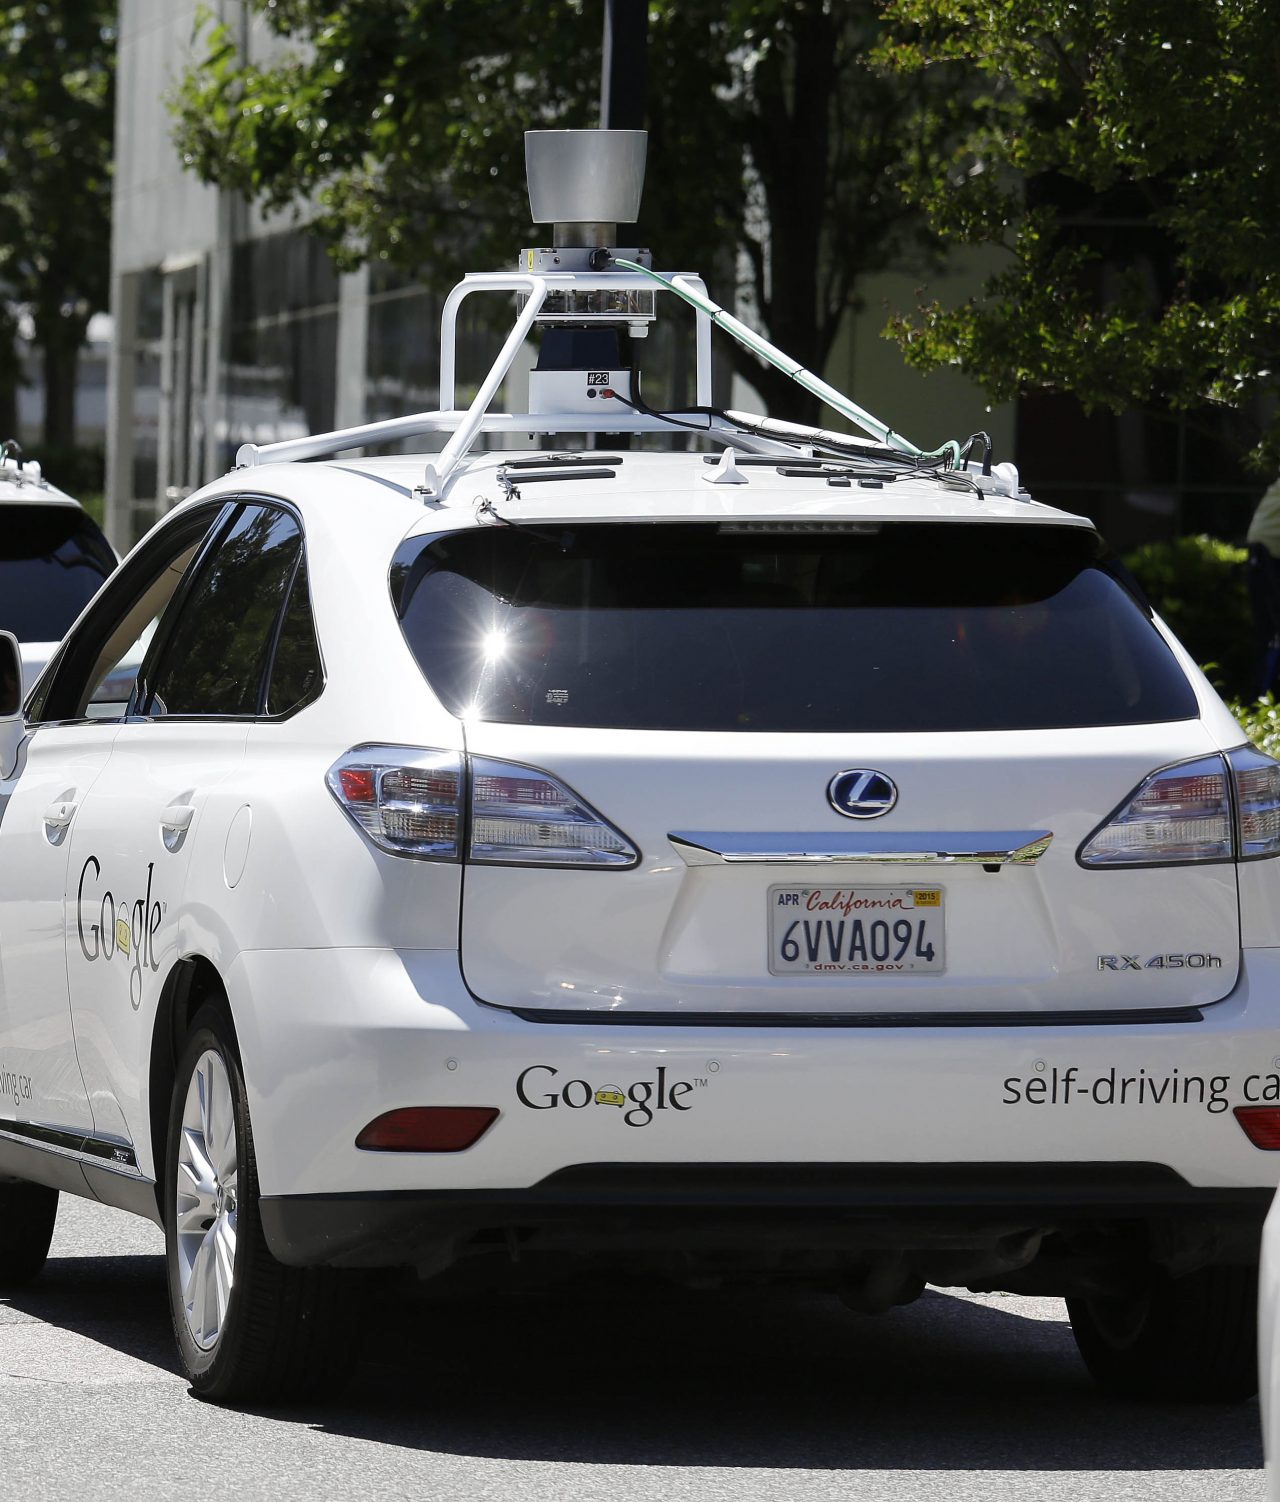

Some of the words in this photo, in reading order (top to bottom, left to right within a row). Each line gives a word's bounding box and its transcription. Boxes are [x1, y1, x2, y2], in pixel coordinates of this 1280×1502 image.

[588, 373, 609, 384] #23
[777, 893, 799, 906] APR
[806, 890, 914, 917] California
[780, 919, 935, 962] 6VVA094
[814, 963, 904, 971] dmv.ca.gov
[19, 1074, 33, 1100] car
[1002, 1067, 1231, 1114] self-driving
